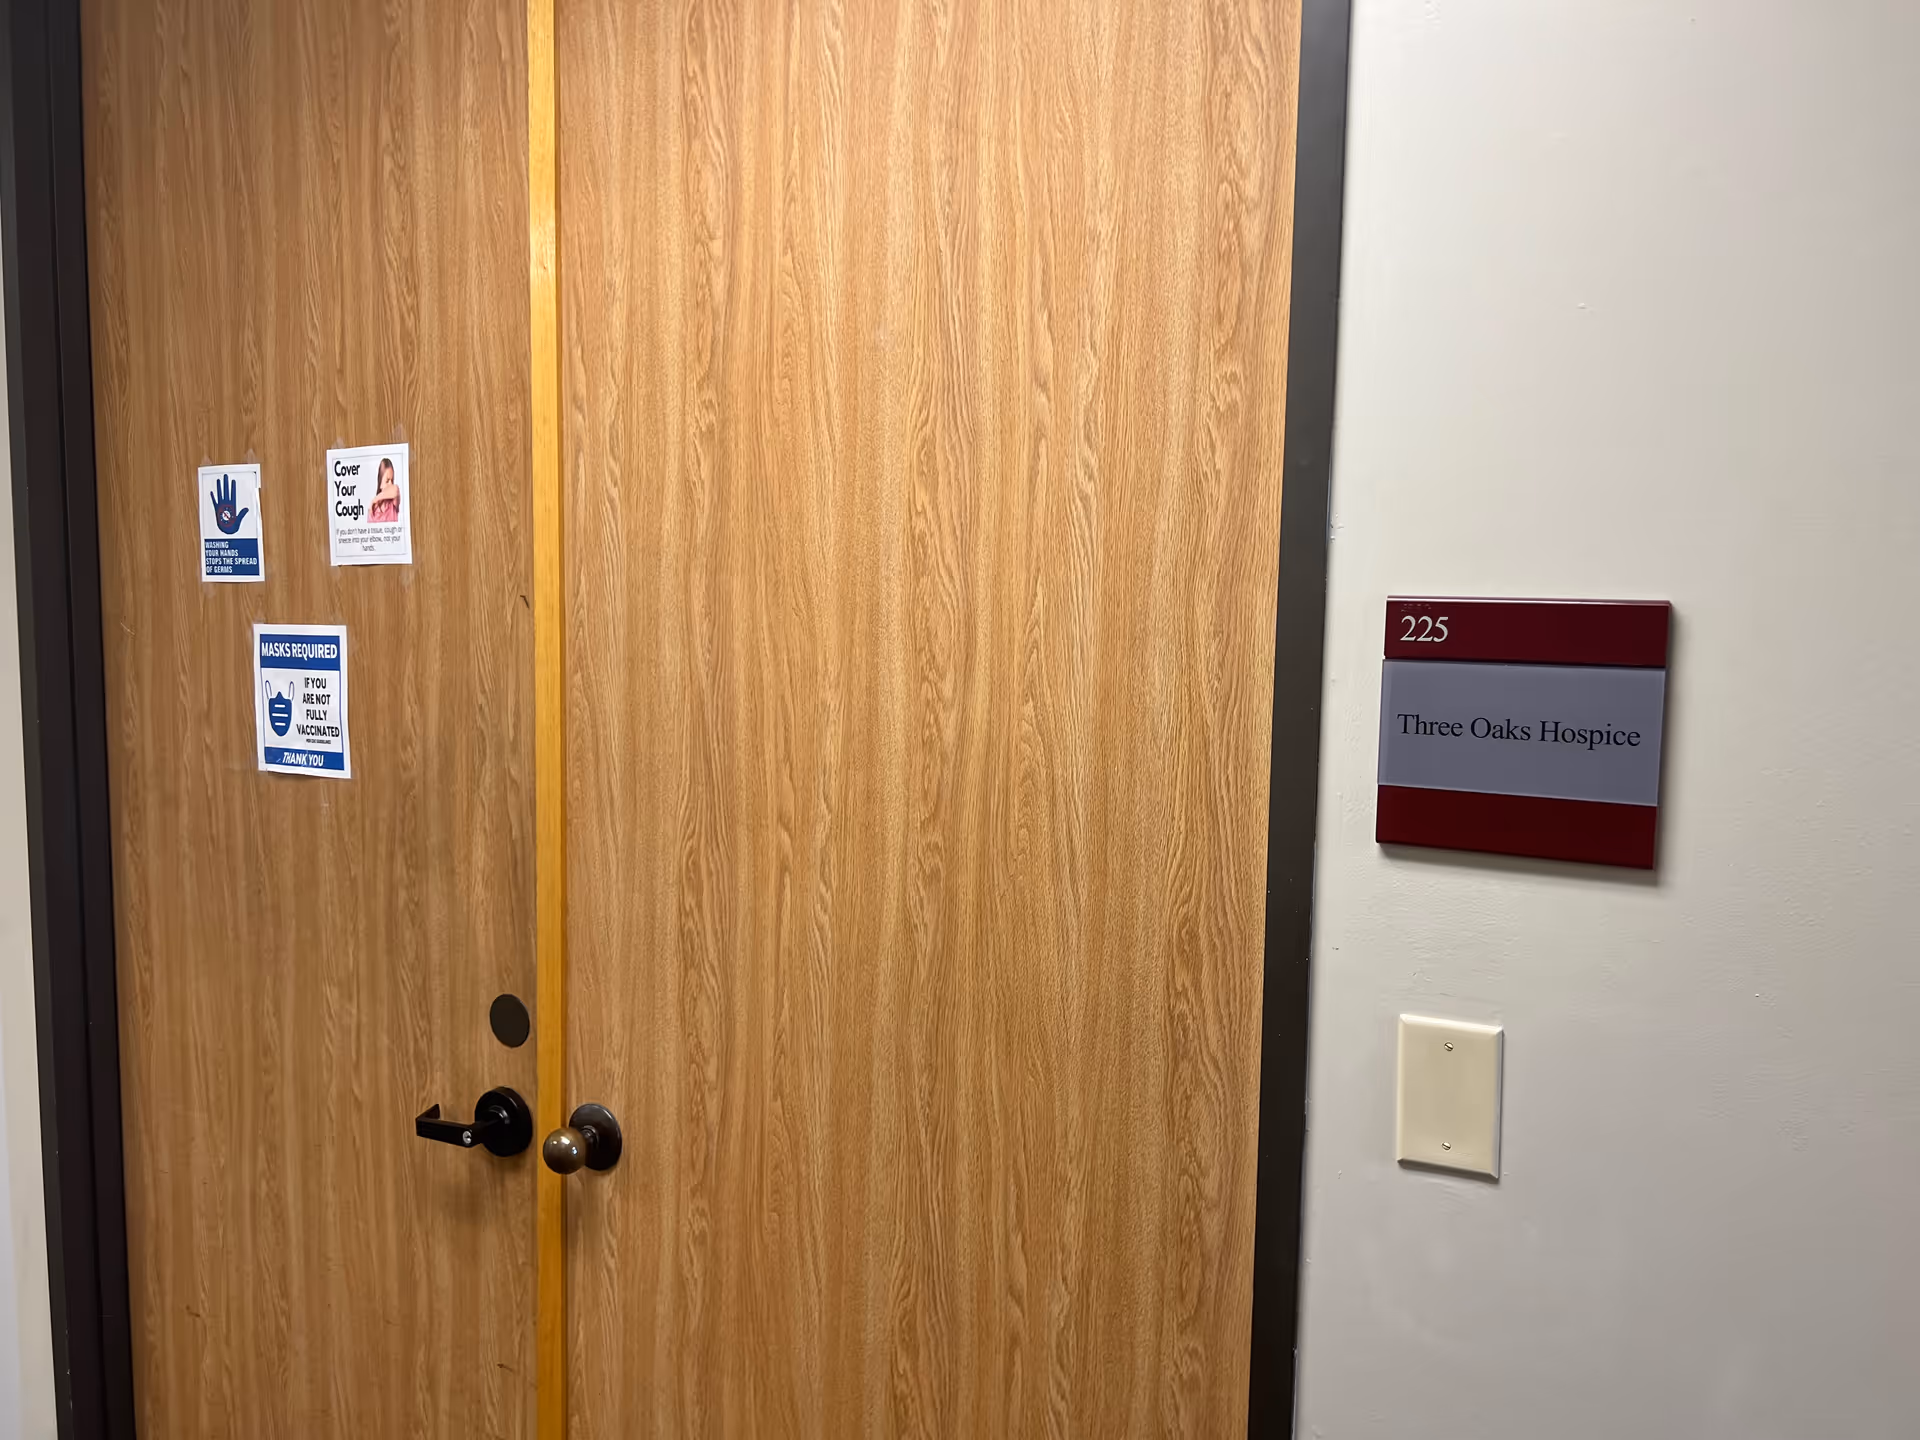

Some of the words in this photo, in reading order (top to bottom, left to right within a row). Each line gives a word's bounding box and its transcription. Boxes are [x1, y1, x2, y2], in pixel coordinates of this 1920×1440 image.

[334, 460, 360, 477] Cover
[334, 480, 356, 497] Your
[335, 498, 364, 521] Cough
[205, 541, 229, 549] WASHING
[205, 549, 219, 557] YOUR
[220, 549, 239, 557] HANDS
[206, 557, 222, 565] STOPS
[222, 557, 233, 565] THE
[234, 557, 258, 565] SPREAD
[206, 565, 213, 573] OF
[213, 565, 233, 573] GERMS
[1400, 615, 1449, 643] 225
[261, 642, 291, 657] MASKS
[291, 643, 338, 661] REQUIRED
[304, 677, 310, 688] IF
[310, 677, 327, 689] YOU
[302, 692, 315, 704] ARE
[315, 693, 331, 705] NOT
[306, 709, 327, 721] FULLY
[296, 723, 340, 738] VACCINATED
[1396, 713, 1464, 737] Three
[1470, 717, 1531, 742] Oaks
[1537, 720, 1641, 751] Hospice
[282, 751, 307, 766] THANK
[308, 753, 324, 767] YOU
